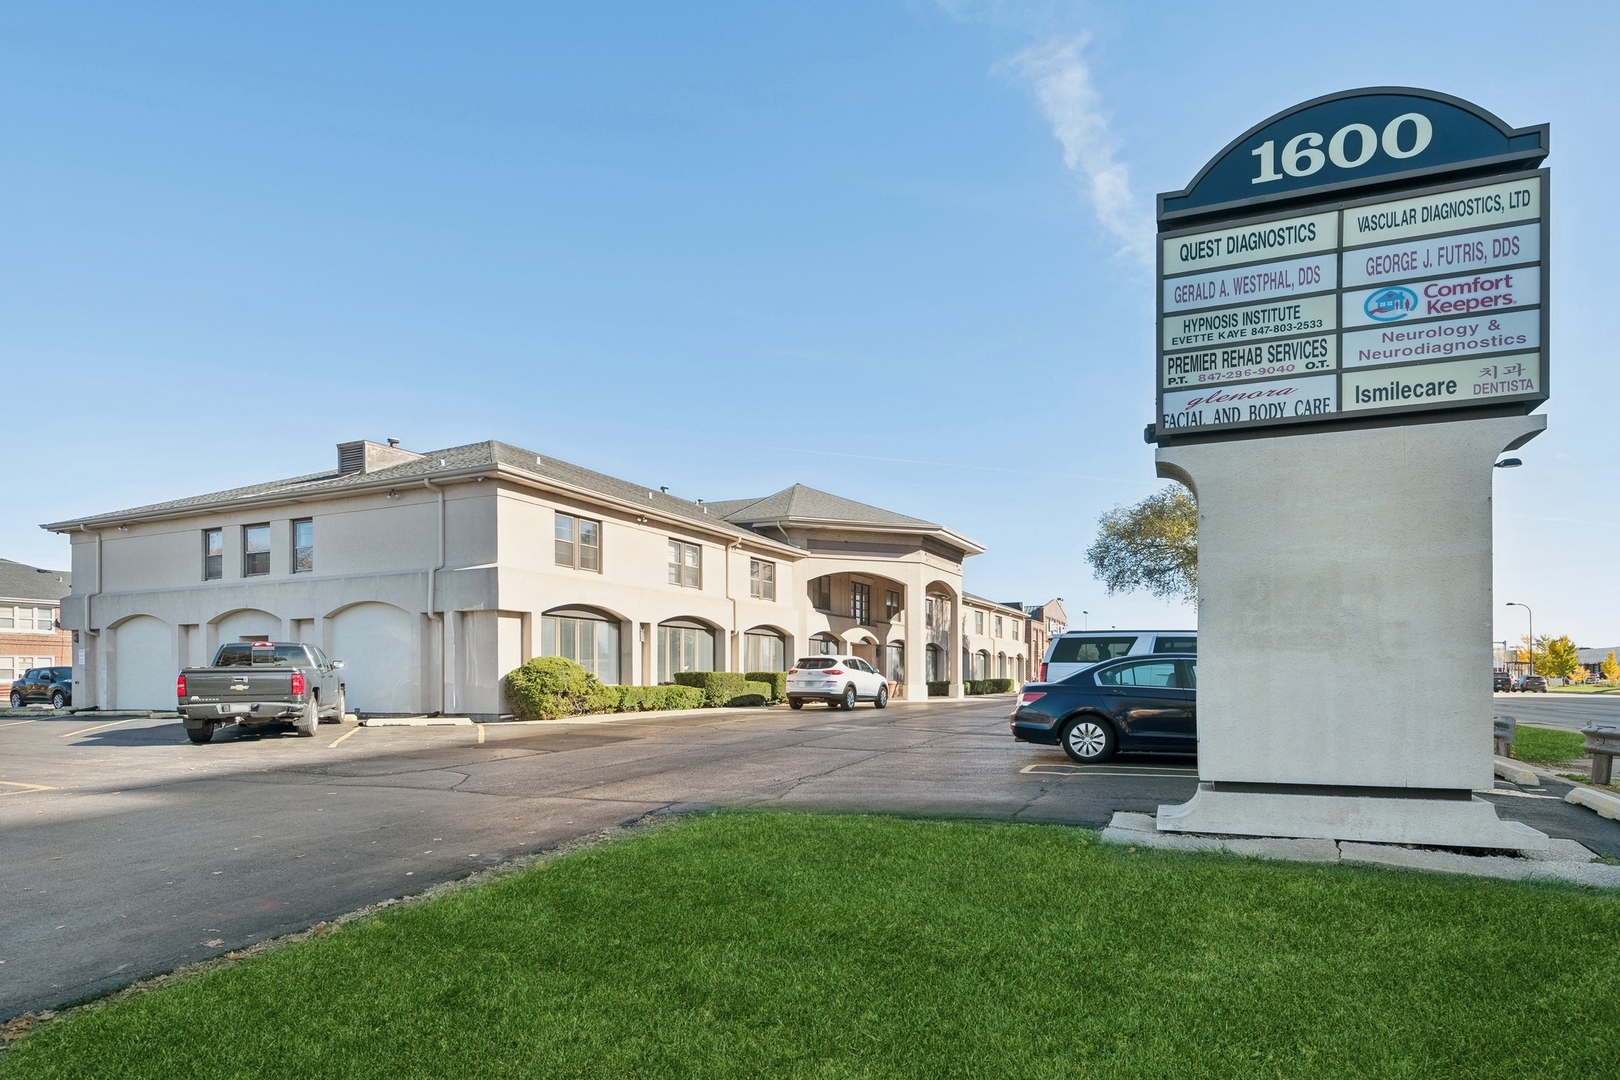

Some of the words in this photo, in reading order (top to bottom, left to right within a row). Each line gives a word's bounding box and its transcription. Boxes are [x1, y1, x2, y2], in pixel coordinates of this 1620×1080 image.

[1251, 112, 1433, 185] 1600
[1357, 208, 1417, 233] VASCULAR
[1421, 193, 1505, 223] DIAGNOSTICS,
[1509, 189, 1531, 209] LTD
[1180, 238, 1222, 262] QUEST
[1227, 222, 1316, 255] DIAGNOSTICS
[1366, 251, 1418, 276] GEORGE
[1423, 249, 1433, 268] J.
[1438, 240, 1488, 266] FUTRIS,
[1492, 235, 1520, 259] DDS
[1174, 281, 1216, 304] GERALD
[1219, 280, 1230, 298] A.
[1233, 270, 1295, 296] WESTPHAL,
[1298, 265, 1321, 286] DDS
[1423, 274, 1513, 298] Comfort
[1172, 333, 1214, 345] EVETTE
[1218, 329, 1247, 340] KAYE
[1251, 319, 1323, 336] 847-803-2533
[1183, 313, 1238, 333] HYPNOSIS
[1242, 305, 1301, 326] INSTITUTE
[1382, 323, 1479, 344] Neurology
[1488, 319, 1501, 331] &
[1168, 352, 1217, 375] PREMIER
[1222, 346, 1263, 369] REHAB
[1267, 338, 1328, 364] SERVICES
[1358, 334, 1527, 361] Neurodiagnostics
[1198, 364, 1296, 382] 847-296-9040
[1305, 360, 1330, 370] O.T.
[1168, 376, 1188, 385] P.T.
[1355, 379, 1458, 403] Ismilecare
[1473, 378, 1534, 395] DENTISTA
[1185, 387, 1299, 411] glenora
[1163, 410, 1206, 429] FACIAL
[1213, 407, 1241, 424] AND
[1249, 402, 1287, 421] BODY
[1294, 397, 1331, 416] CARE
